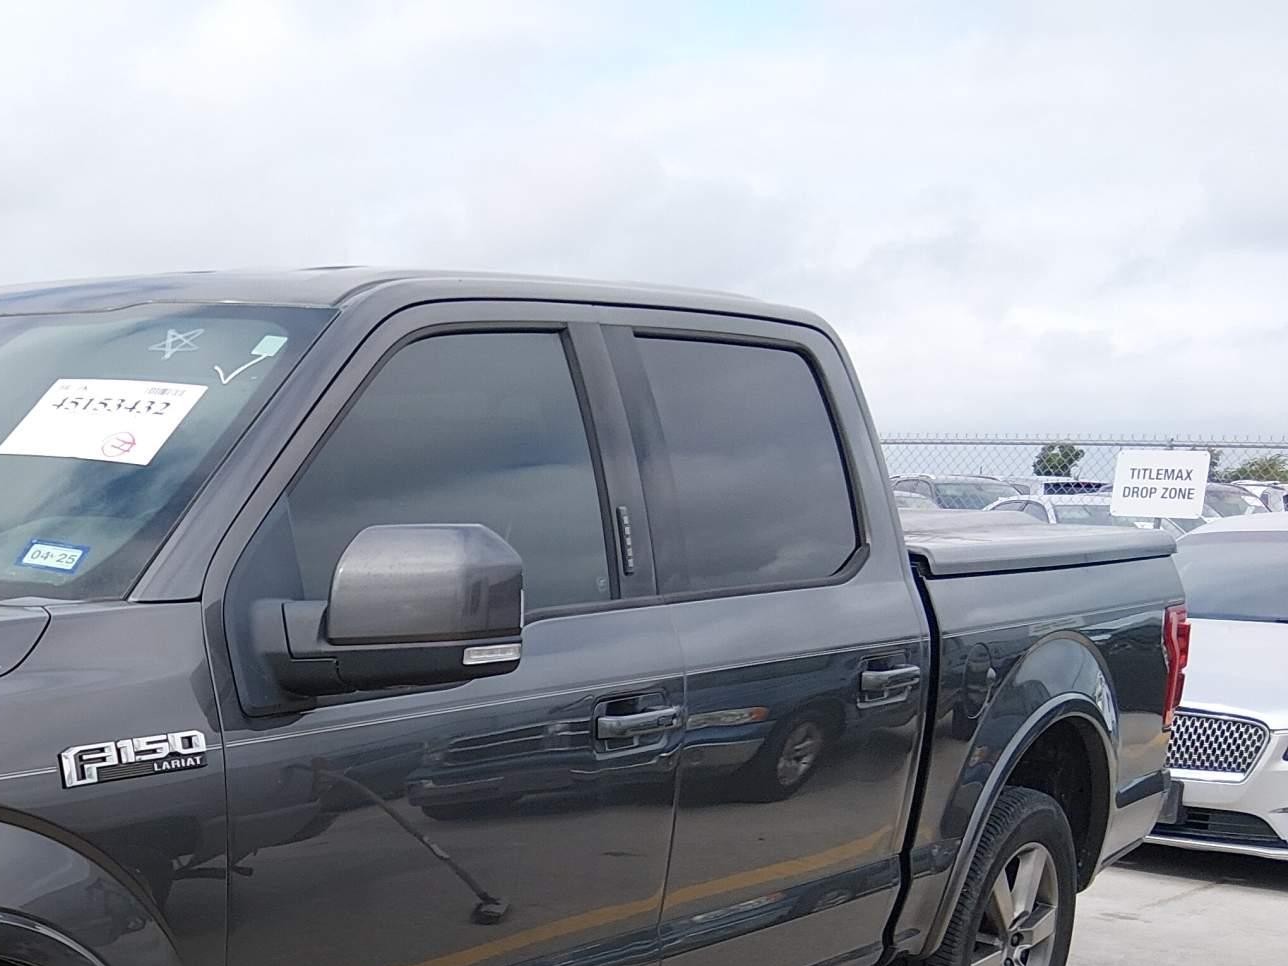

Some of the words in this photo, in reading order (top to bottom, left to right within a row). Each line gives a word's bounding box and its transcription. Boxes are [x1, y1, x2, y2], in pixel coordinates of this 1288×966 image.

[1130, 468, 1193, 480] TITLEMAX
[1122, 486, 1157, 498] DROP
[1160, 487, 1195, 500] ZONE
[154, 756, 202, 771] LARIAT
